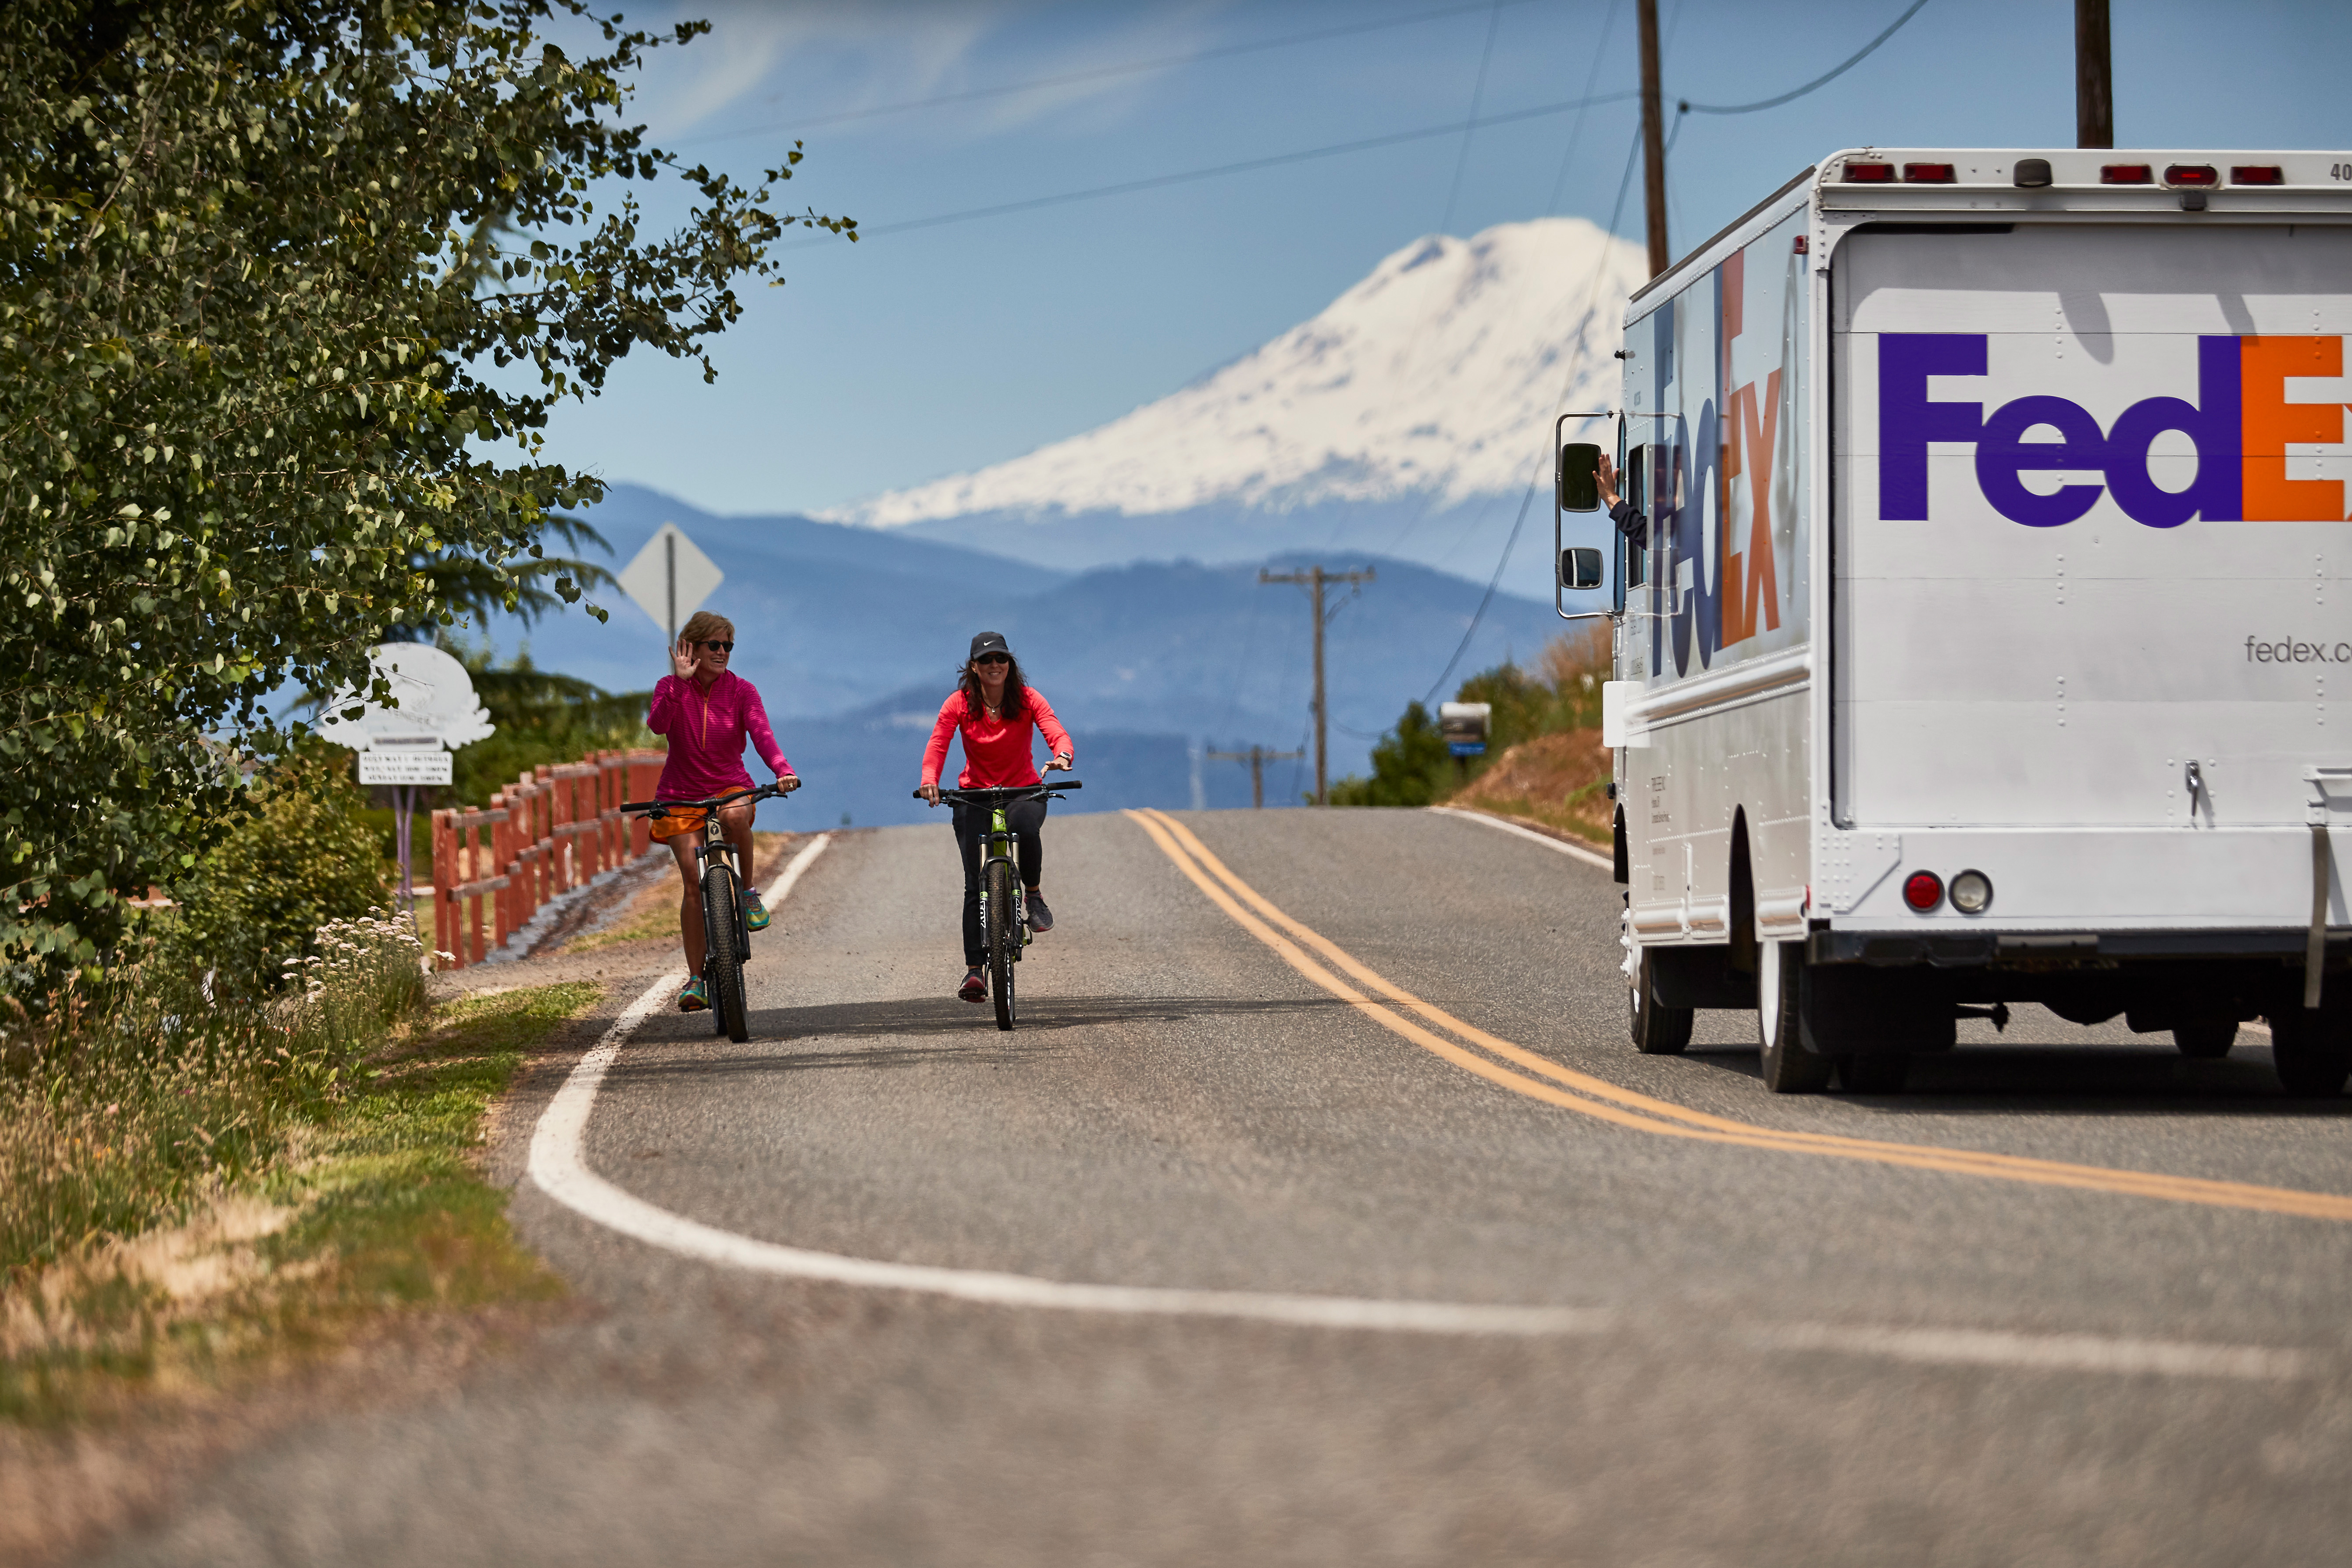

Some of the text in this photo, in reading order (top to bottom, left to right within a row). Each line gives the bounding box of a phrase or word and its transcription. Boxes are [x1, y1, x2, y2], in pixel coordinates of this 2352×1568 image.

[2330, 163, 2352, 181] 40
[1652, 249, 1782, 678] FedEx
[1878, 333, 2352, 528] FedE
[2244, 635, 2352, 663] fedex.c
